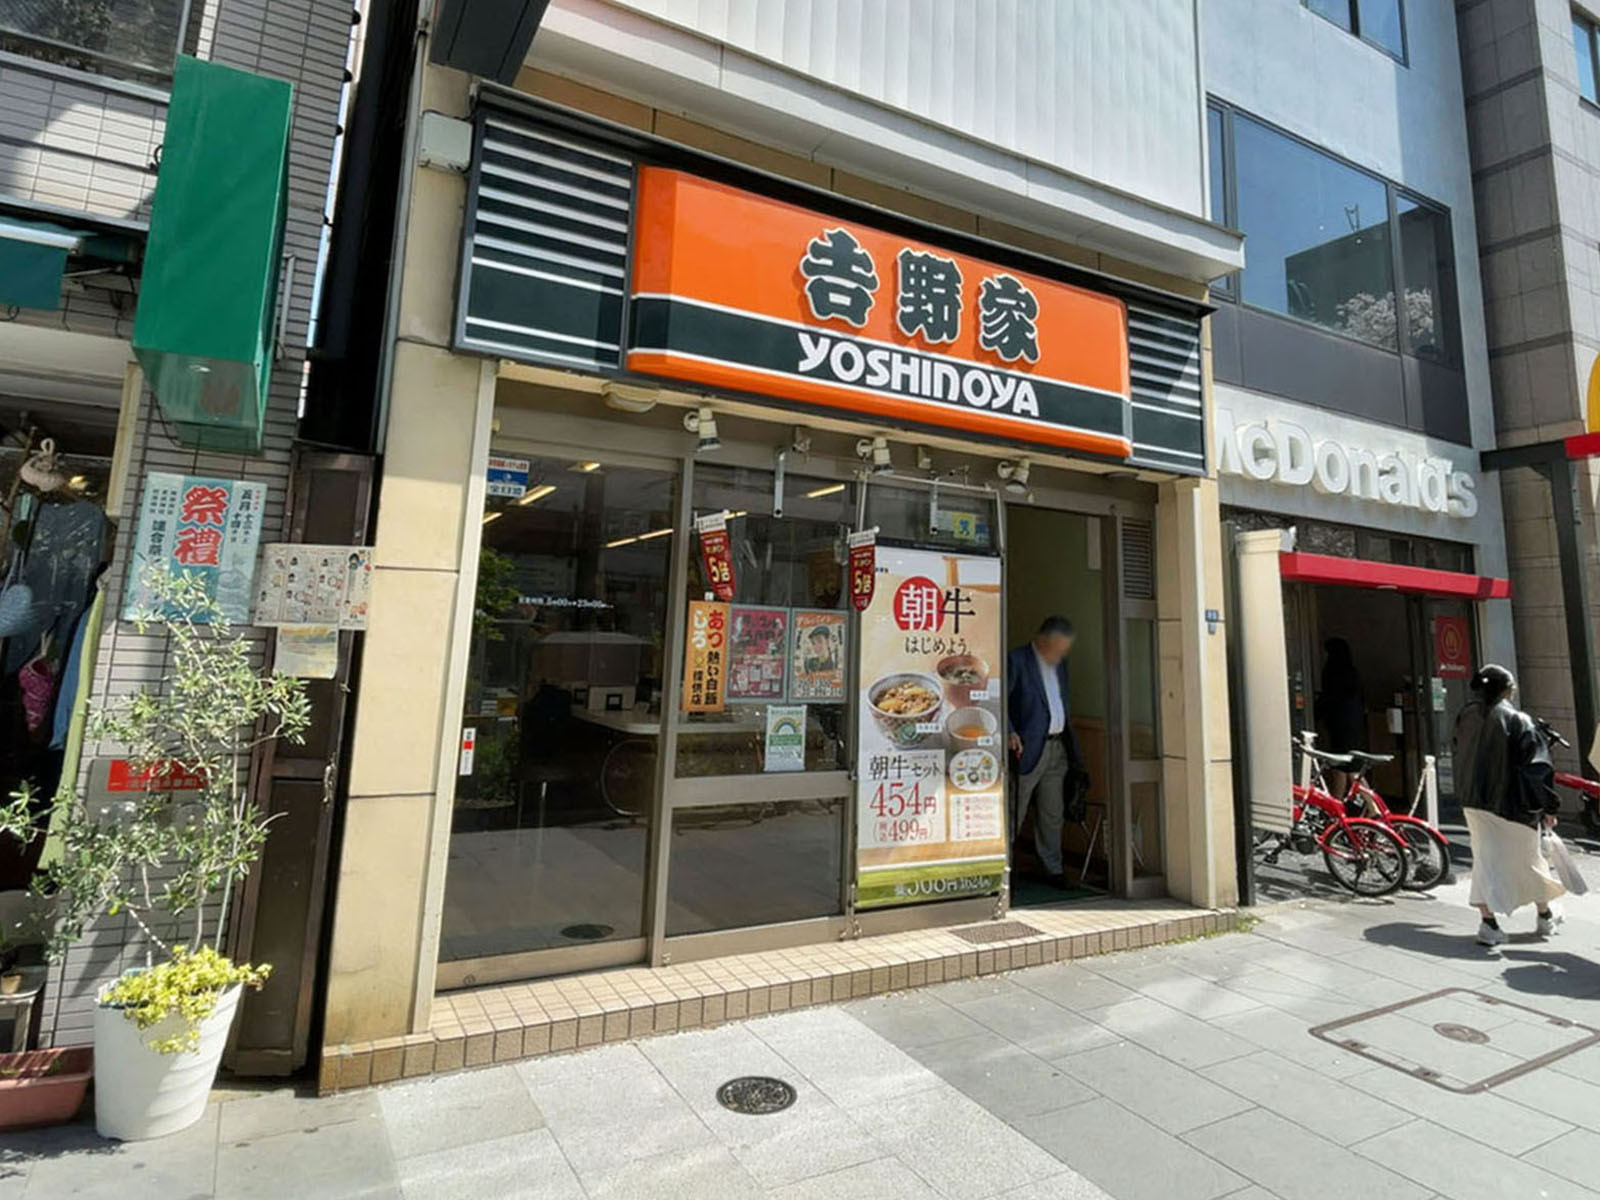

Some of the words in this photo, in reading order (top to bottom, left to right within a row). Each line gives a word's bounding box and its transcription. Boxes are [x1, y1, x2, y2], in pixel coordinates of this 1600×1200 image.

[800, 227, 1041, 363] 吉野家
[798, 333, 1039, 417] YOSHINOYA
[899, 584, 976, 635] 朝牛
[869, 781, 937, 818] 454円
